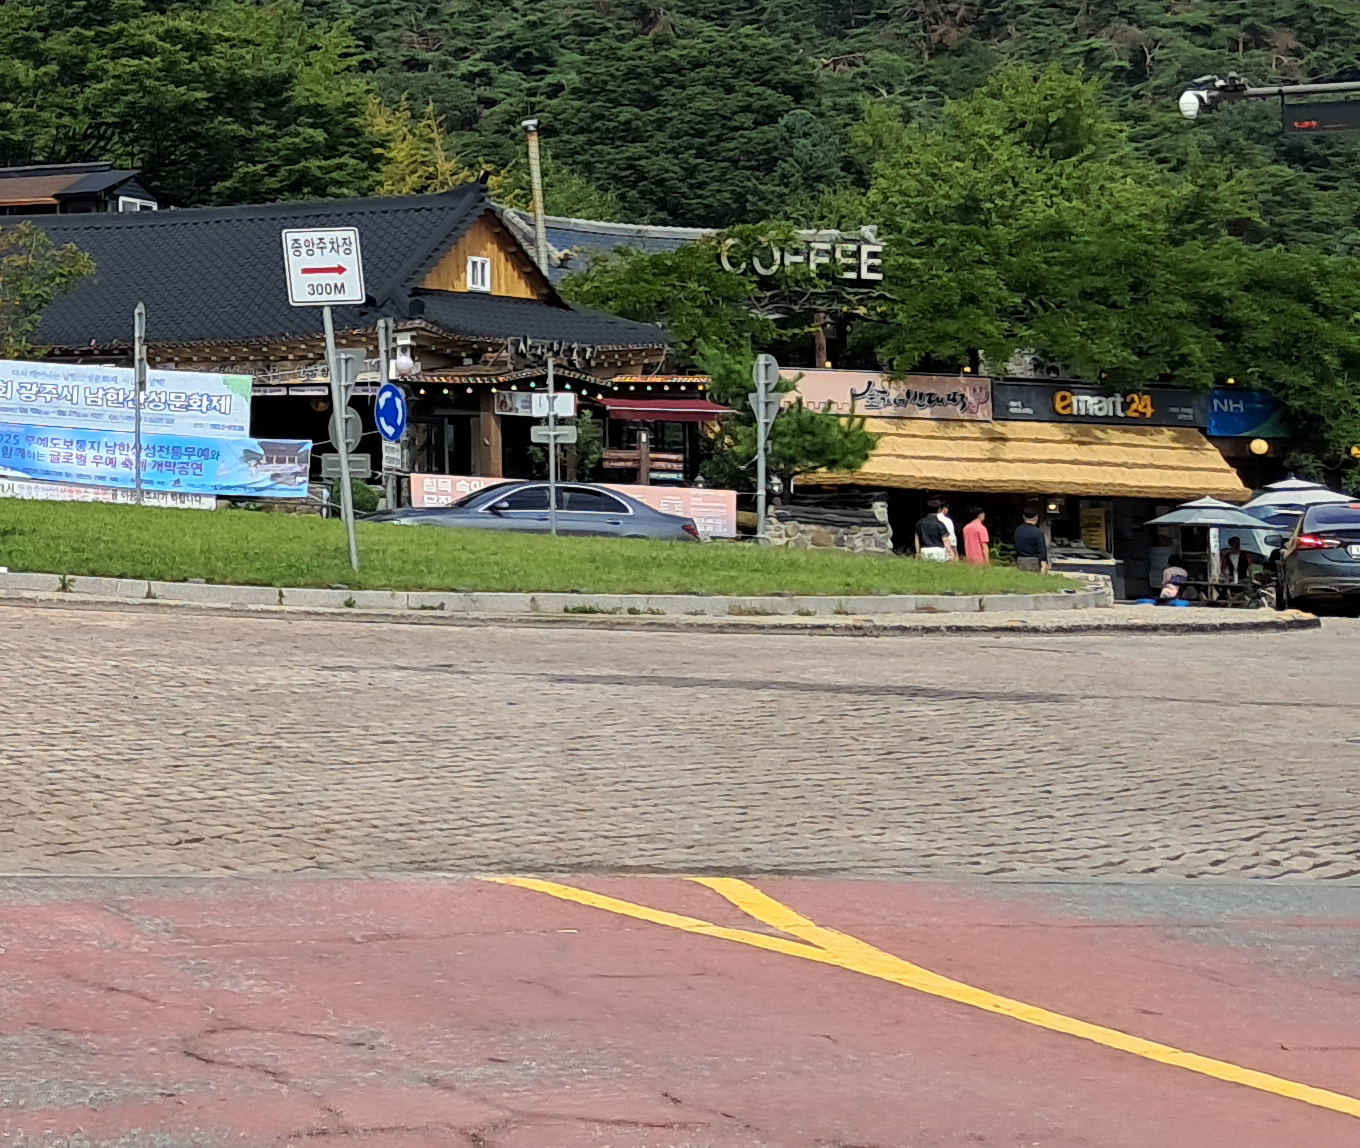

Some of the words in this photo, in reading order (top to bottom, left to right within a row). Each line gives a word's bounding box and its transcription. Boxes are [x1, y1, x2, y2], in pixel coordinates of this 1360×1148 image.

[290, 235, 353, 258] 중앙주차장
[720, 237, 884, 281] COFFEE
[307, 282, 346, 296] 300M
[17, 381, 80, 406] 광주시
[83, 386, 233, 416] 남한산성문화제
[1054, 390, 1155, 418] emart24
[1212, 398, 1244, 413] NH
